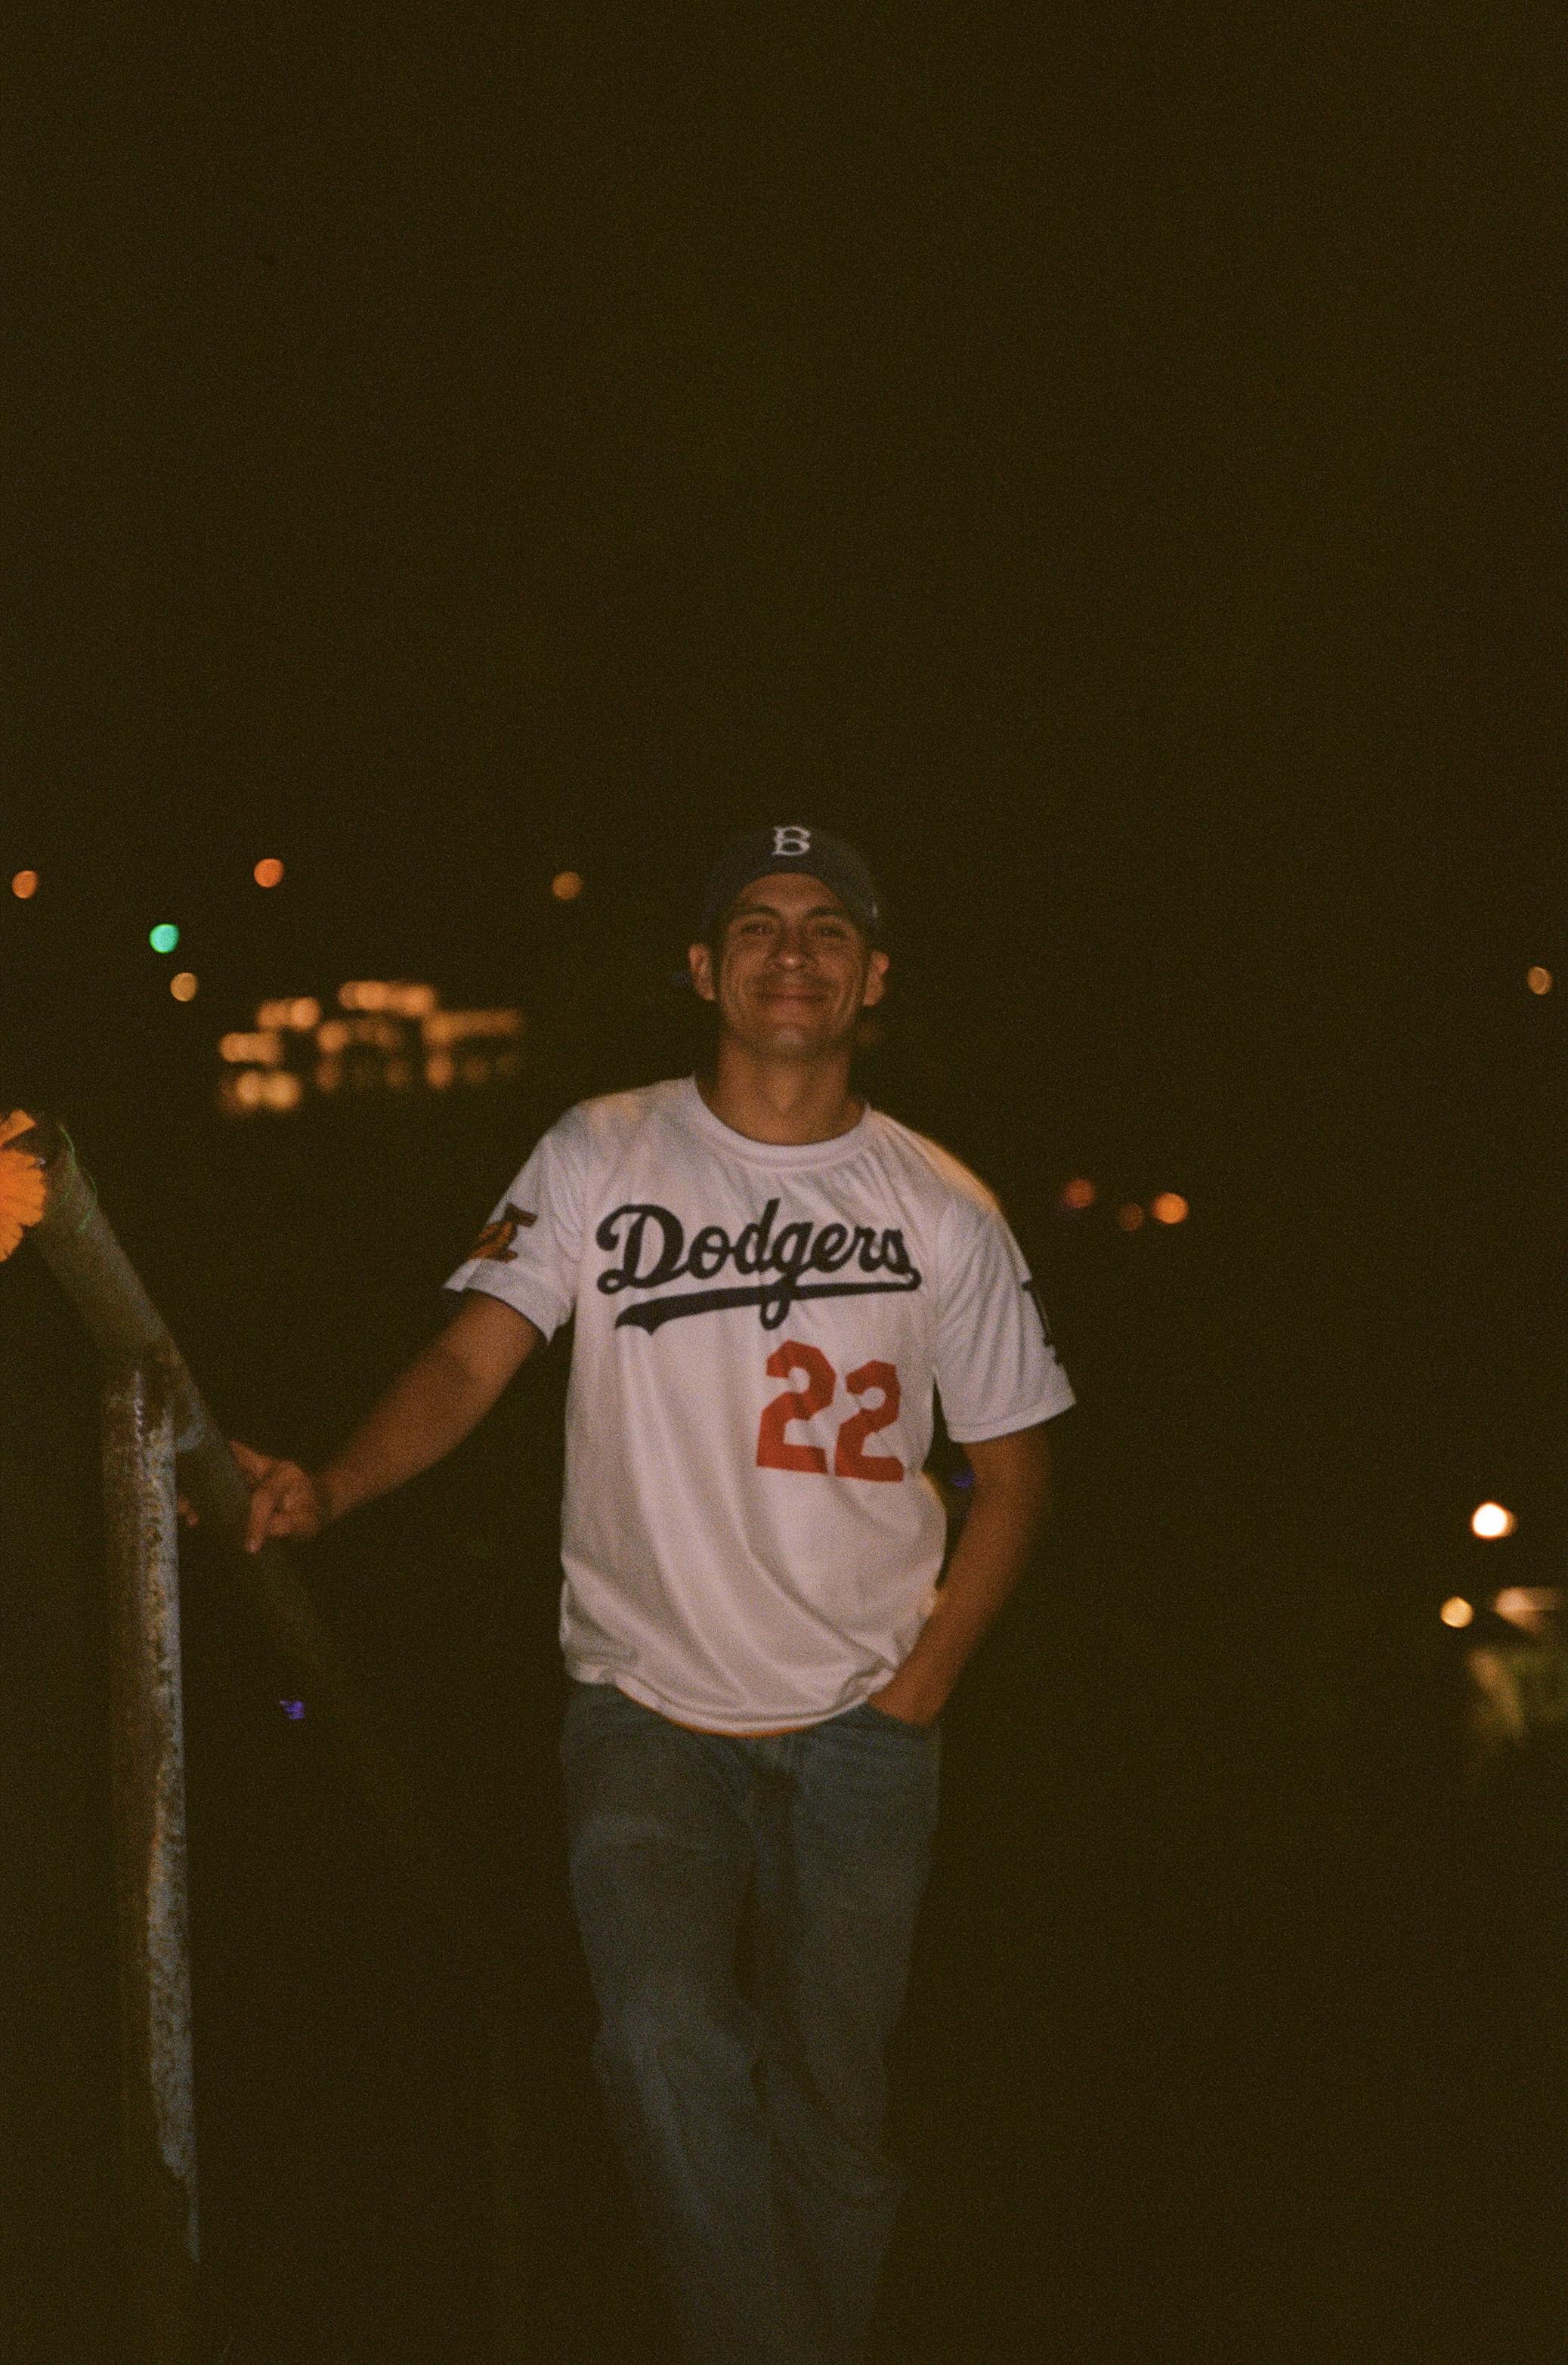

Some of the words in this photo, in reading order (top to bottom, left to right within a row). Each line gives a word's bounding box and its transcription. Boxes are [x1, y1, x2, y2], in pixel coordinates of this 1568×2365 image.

[772, 826, 811, 855] B
[595, 1198, 922, 1336] Dodgers
[757, 1340, 904, 1482] 22
